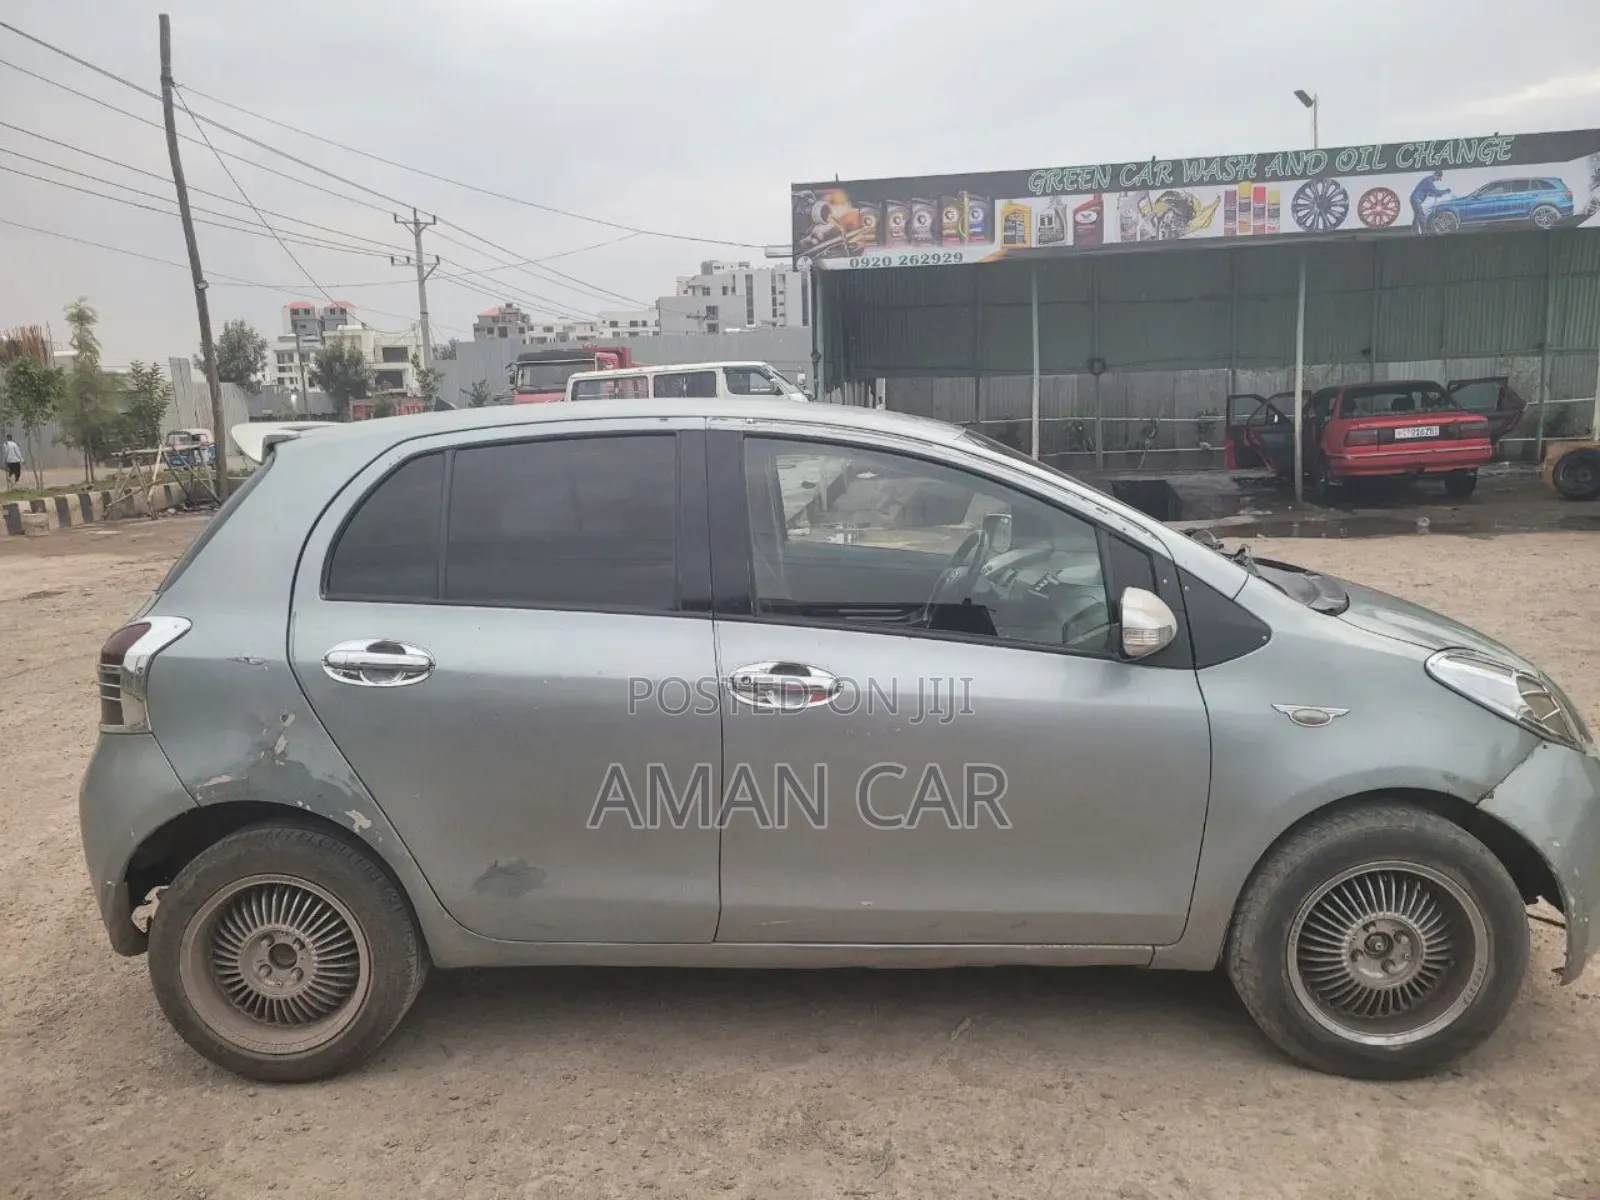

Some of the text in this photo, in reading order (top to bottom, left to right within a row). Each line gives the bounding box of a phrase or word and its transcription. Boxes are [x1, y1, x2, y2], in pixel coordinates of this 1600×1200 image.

[1028, 137, 1514, 194] GREEN CAR WASH AND OIL CHANGE
[849, 252, 963, 269] 0920 262929
